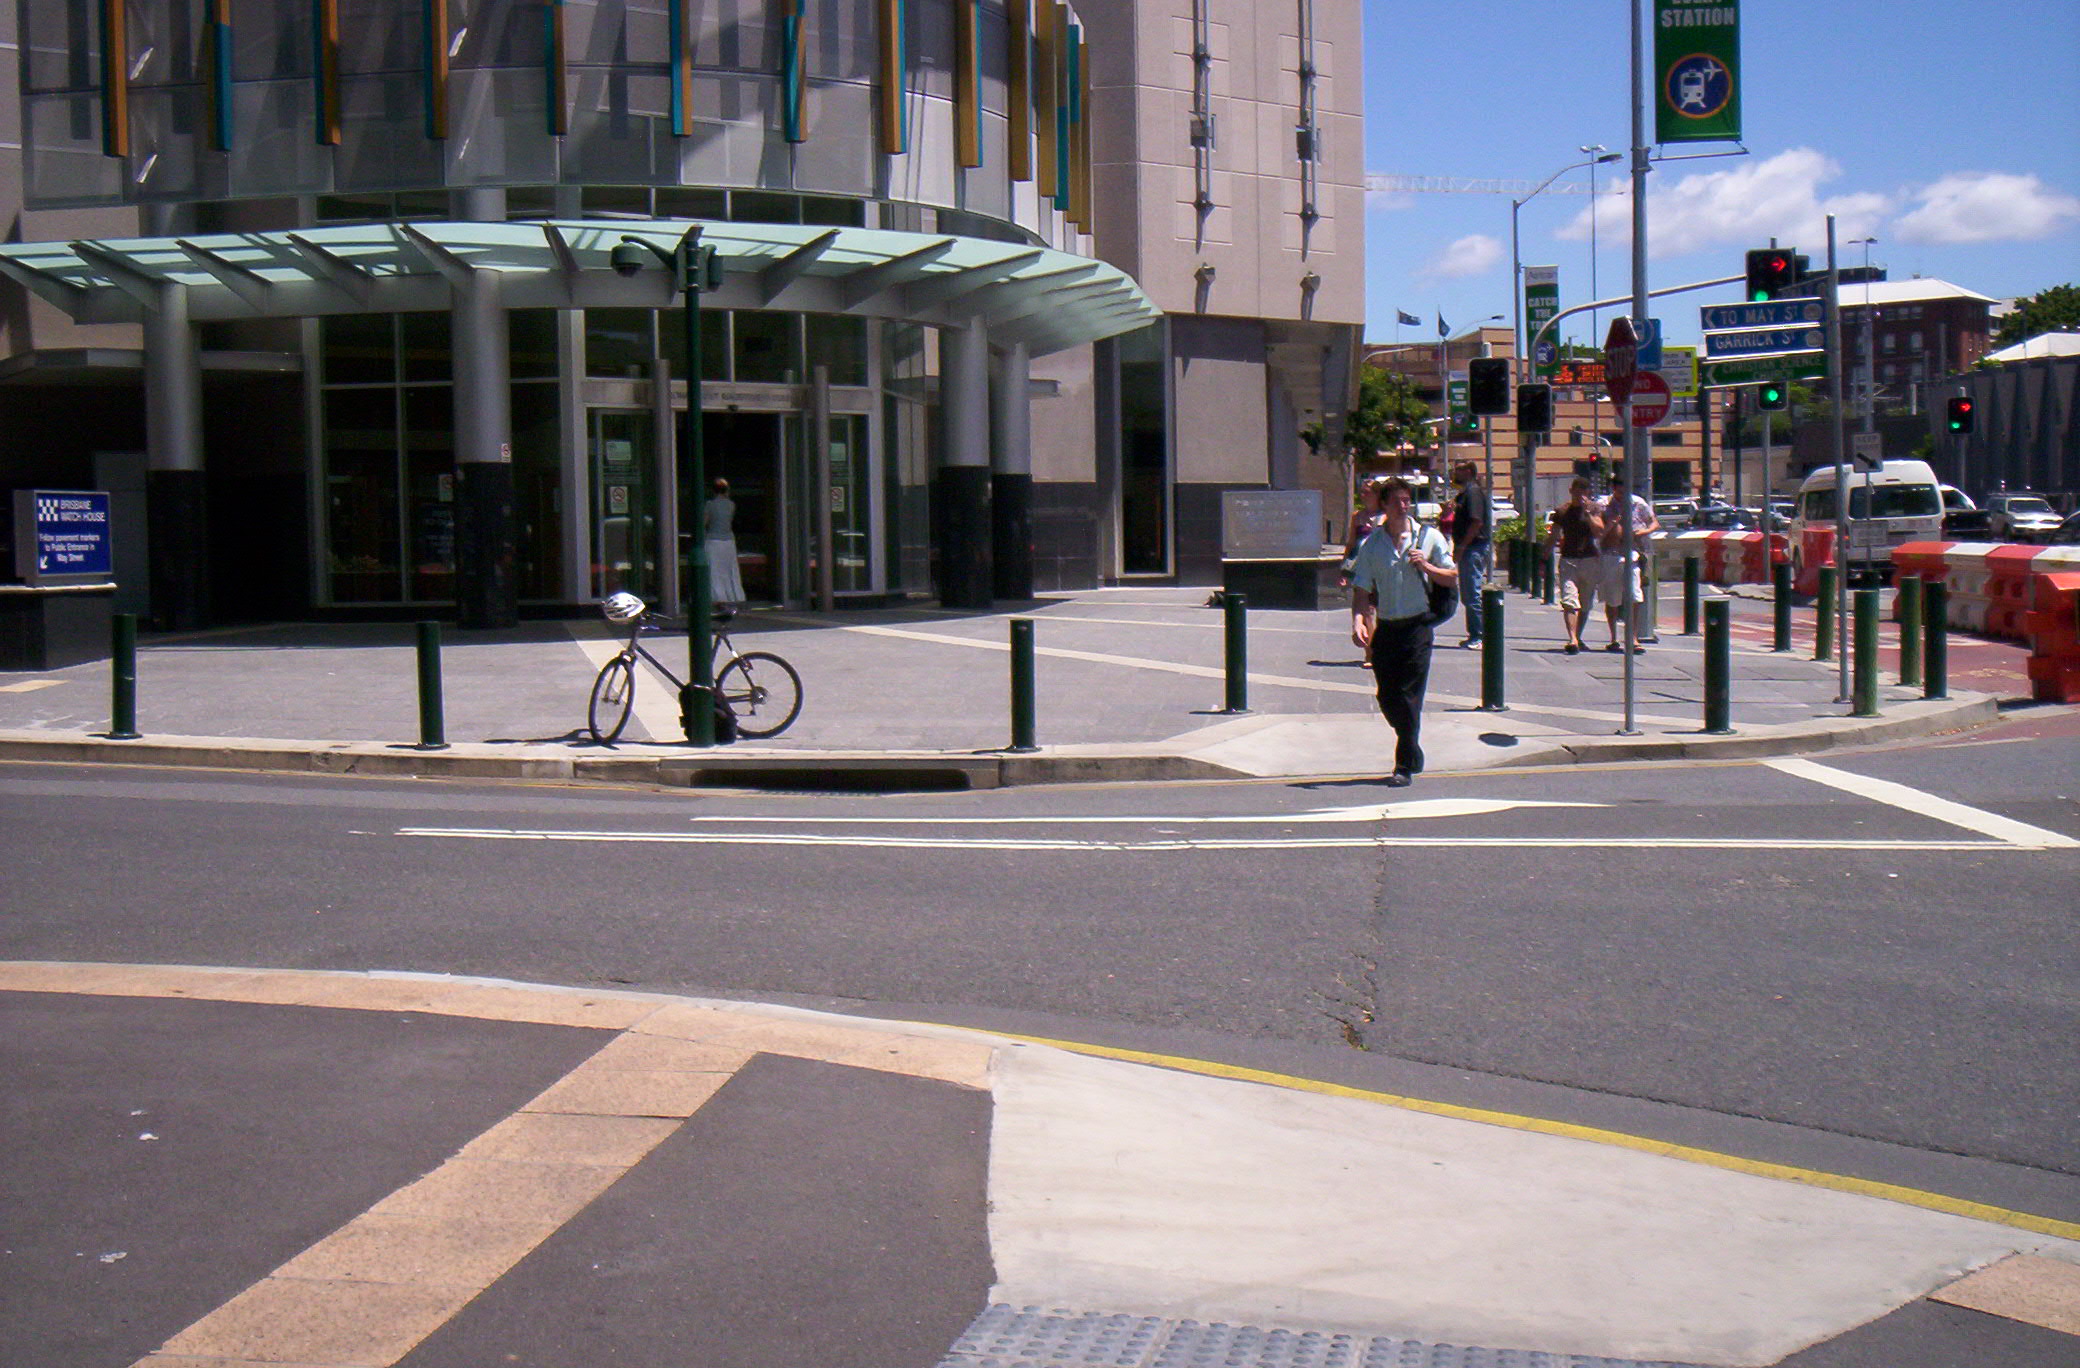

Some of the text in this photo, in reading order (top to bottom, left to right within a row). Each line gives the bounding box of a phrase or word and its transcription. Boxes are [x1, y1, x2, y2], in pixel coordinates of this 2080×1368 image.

[1661, 7, 1735, 27] STATION
[1528, 296, 1557, 307] CATCH
[1720, 310, 1737, 325] TO
[1746, 307, 1776, 323] MAY
[1715, 332, 1774, 349] GARRICK
[1605, 345, 1635, 379] STOP
[1633, 379, 1651, 390] NO
[1632, 407, 1662, 418] NTRY
[61, 500, 92, 510] BRISBANE
[61, 512, 106, 522] WATCH HOUSE
